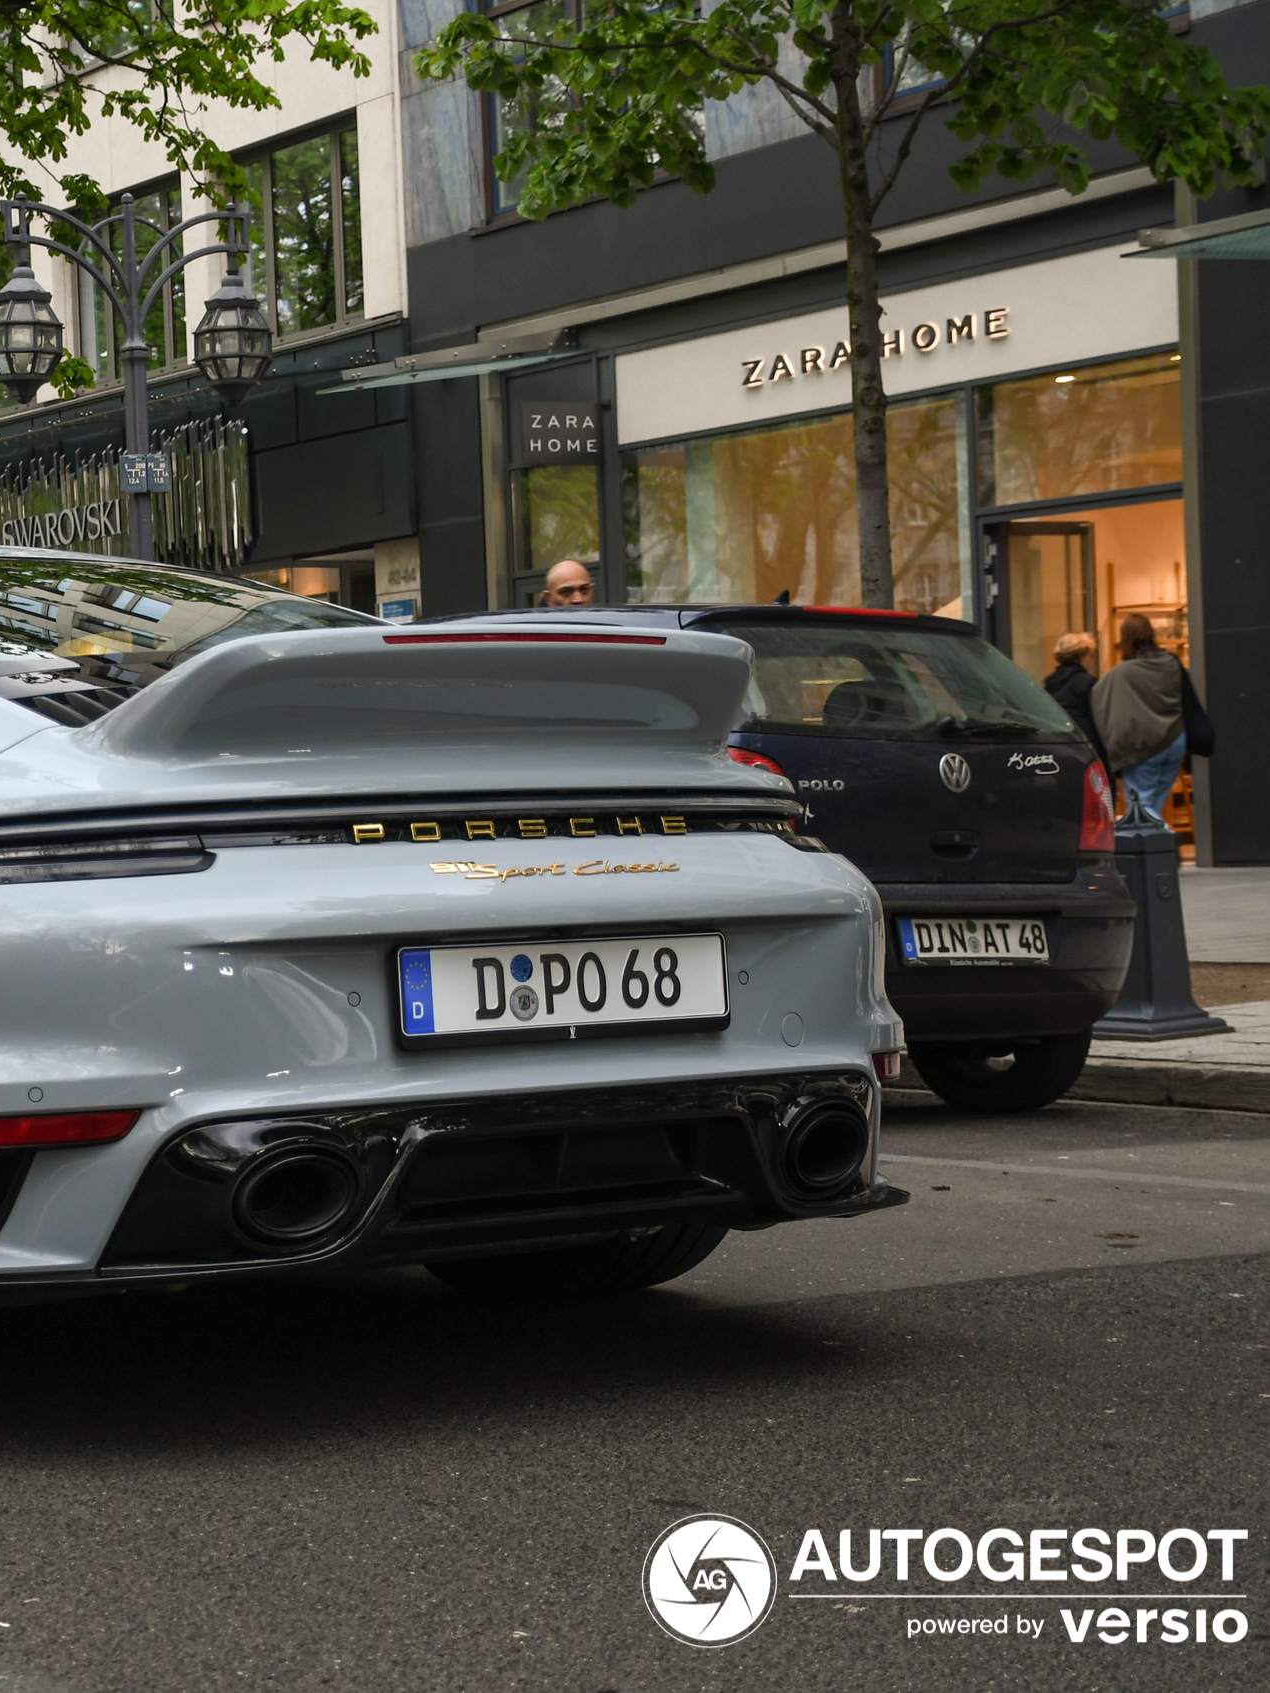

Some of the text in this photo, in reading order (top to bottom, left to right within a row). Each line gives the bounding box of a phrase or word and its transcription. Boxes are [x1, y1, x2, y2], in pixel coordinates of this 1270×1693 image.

[742, 308, 1010, 387] ZARA HOME
[531, 415, 595, 429] ZARA
[530, 439, 598, 453] HOME
[2, 499, 122, 548] SWAROVSKI
[798, 779, 845, 791] POLO
[353, 816, 688, 843] PORSCHE
[465, 862, 566, 882] Sport
[573, 860, 680, 876] Classic
[906, 943, 913, 952] D
[914, 923, 1045, 954] DIN AT 48
[472, 957, 507, 1021] D
[539, 951, 607, 1015] PO
[621, 947, 681, 1010] 68
[412, 1001, 424, 1019] D
